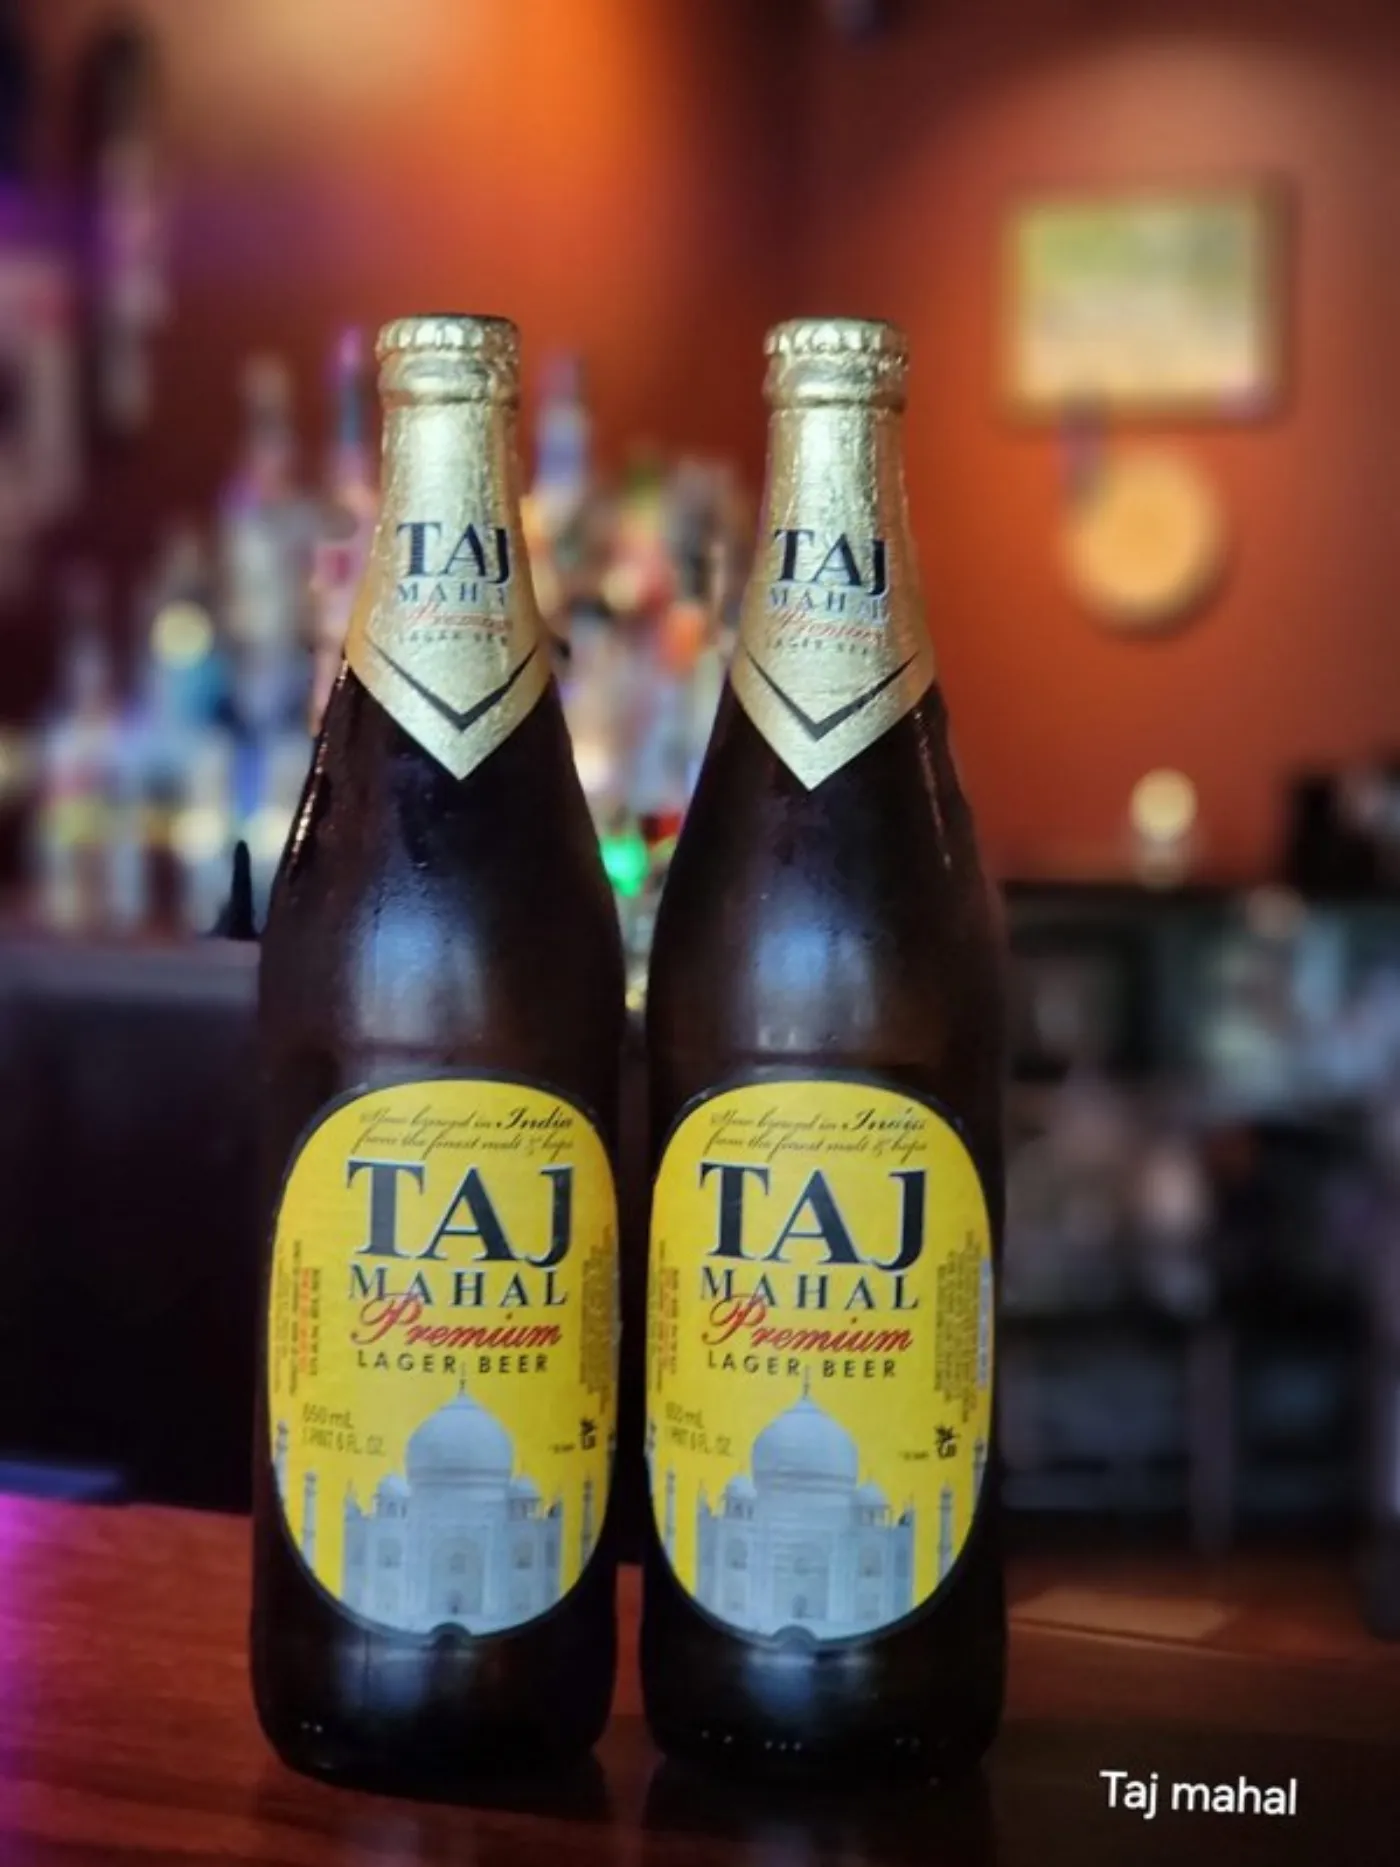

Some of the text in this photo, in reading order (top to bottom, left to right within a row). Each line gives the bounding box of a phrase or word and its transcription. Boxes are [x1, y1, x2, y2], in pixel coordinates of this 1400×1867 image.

[396, 522, 509, 583] TAJ
[774, 529, 885, 595] TAJ
[496, 1105, 572, 1129] India
[347, 1160, 572, 1267] TAJ
[700, 1163, 926, 1271] TAJ
[350, 1265, 568, 1307] MAHAL
[701, 1267, 919, 1310] MAHAL
[351, 1292, 562, 1348] Premium
[702, 1294, 914, 1352] Premium
[358, 1350, 548, 1374] LAGER BEER
[708, 1350, 896, 1378] LAGER BEER
